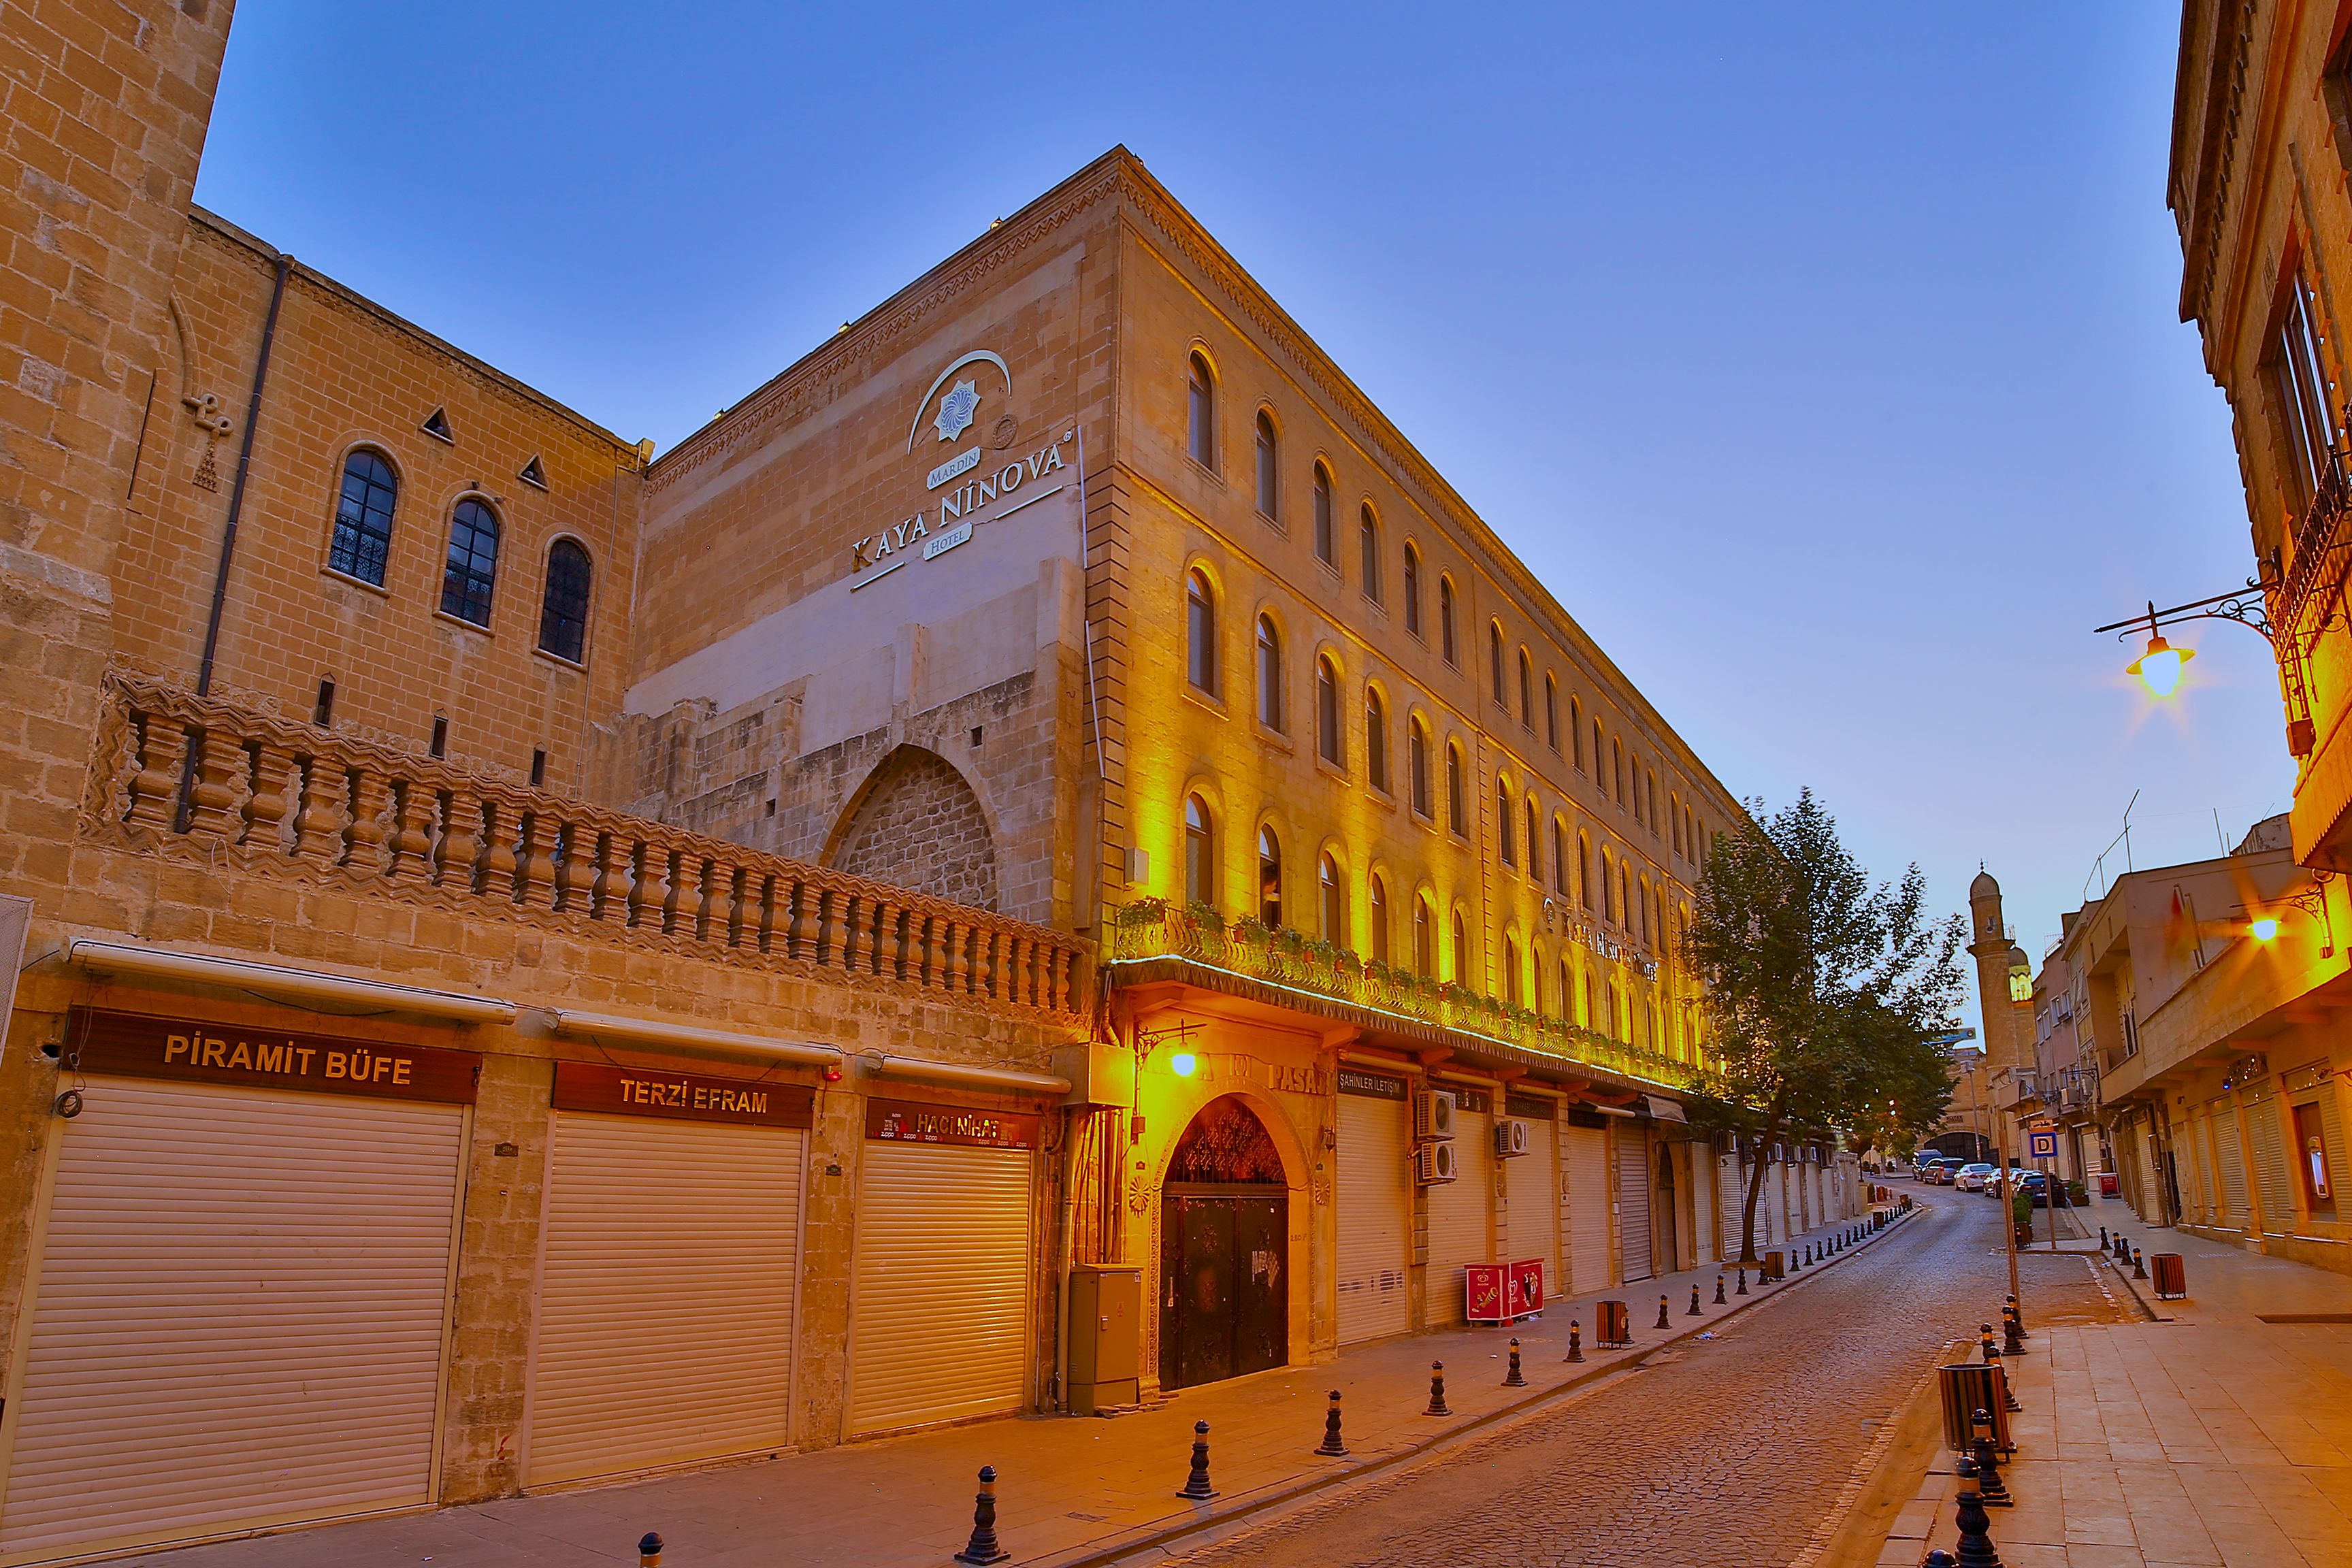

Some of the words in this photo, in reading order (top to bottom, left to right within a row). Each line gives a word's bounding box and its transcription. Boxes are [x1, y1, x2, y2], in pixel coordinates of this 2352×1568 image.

[852, 513, 929, 572] KAYA
[939, 443, 1066, 527] NİNOVA
[930, 530, 964, 555] HOTEL
[164, 1030, 316, 1075] PİRAMİT
[325, 1049, 412, 1085] BÜFE
[620, 1079, 687, 1107] TERZİ
[693, 1087, 768, 1113] EFRAM
[2037, 1138, 2050, 1152] D
